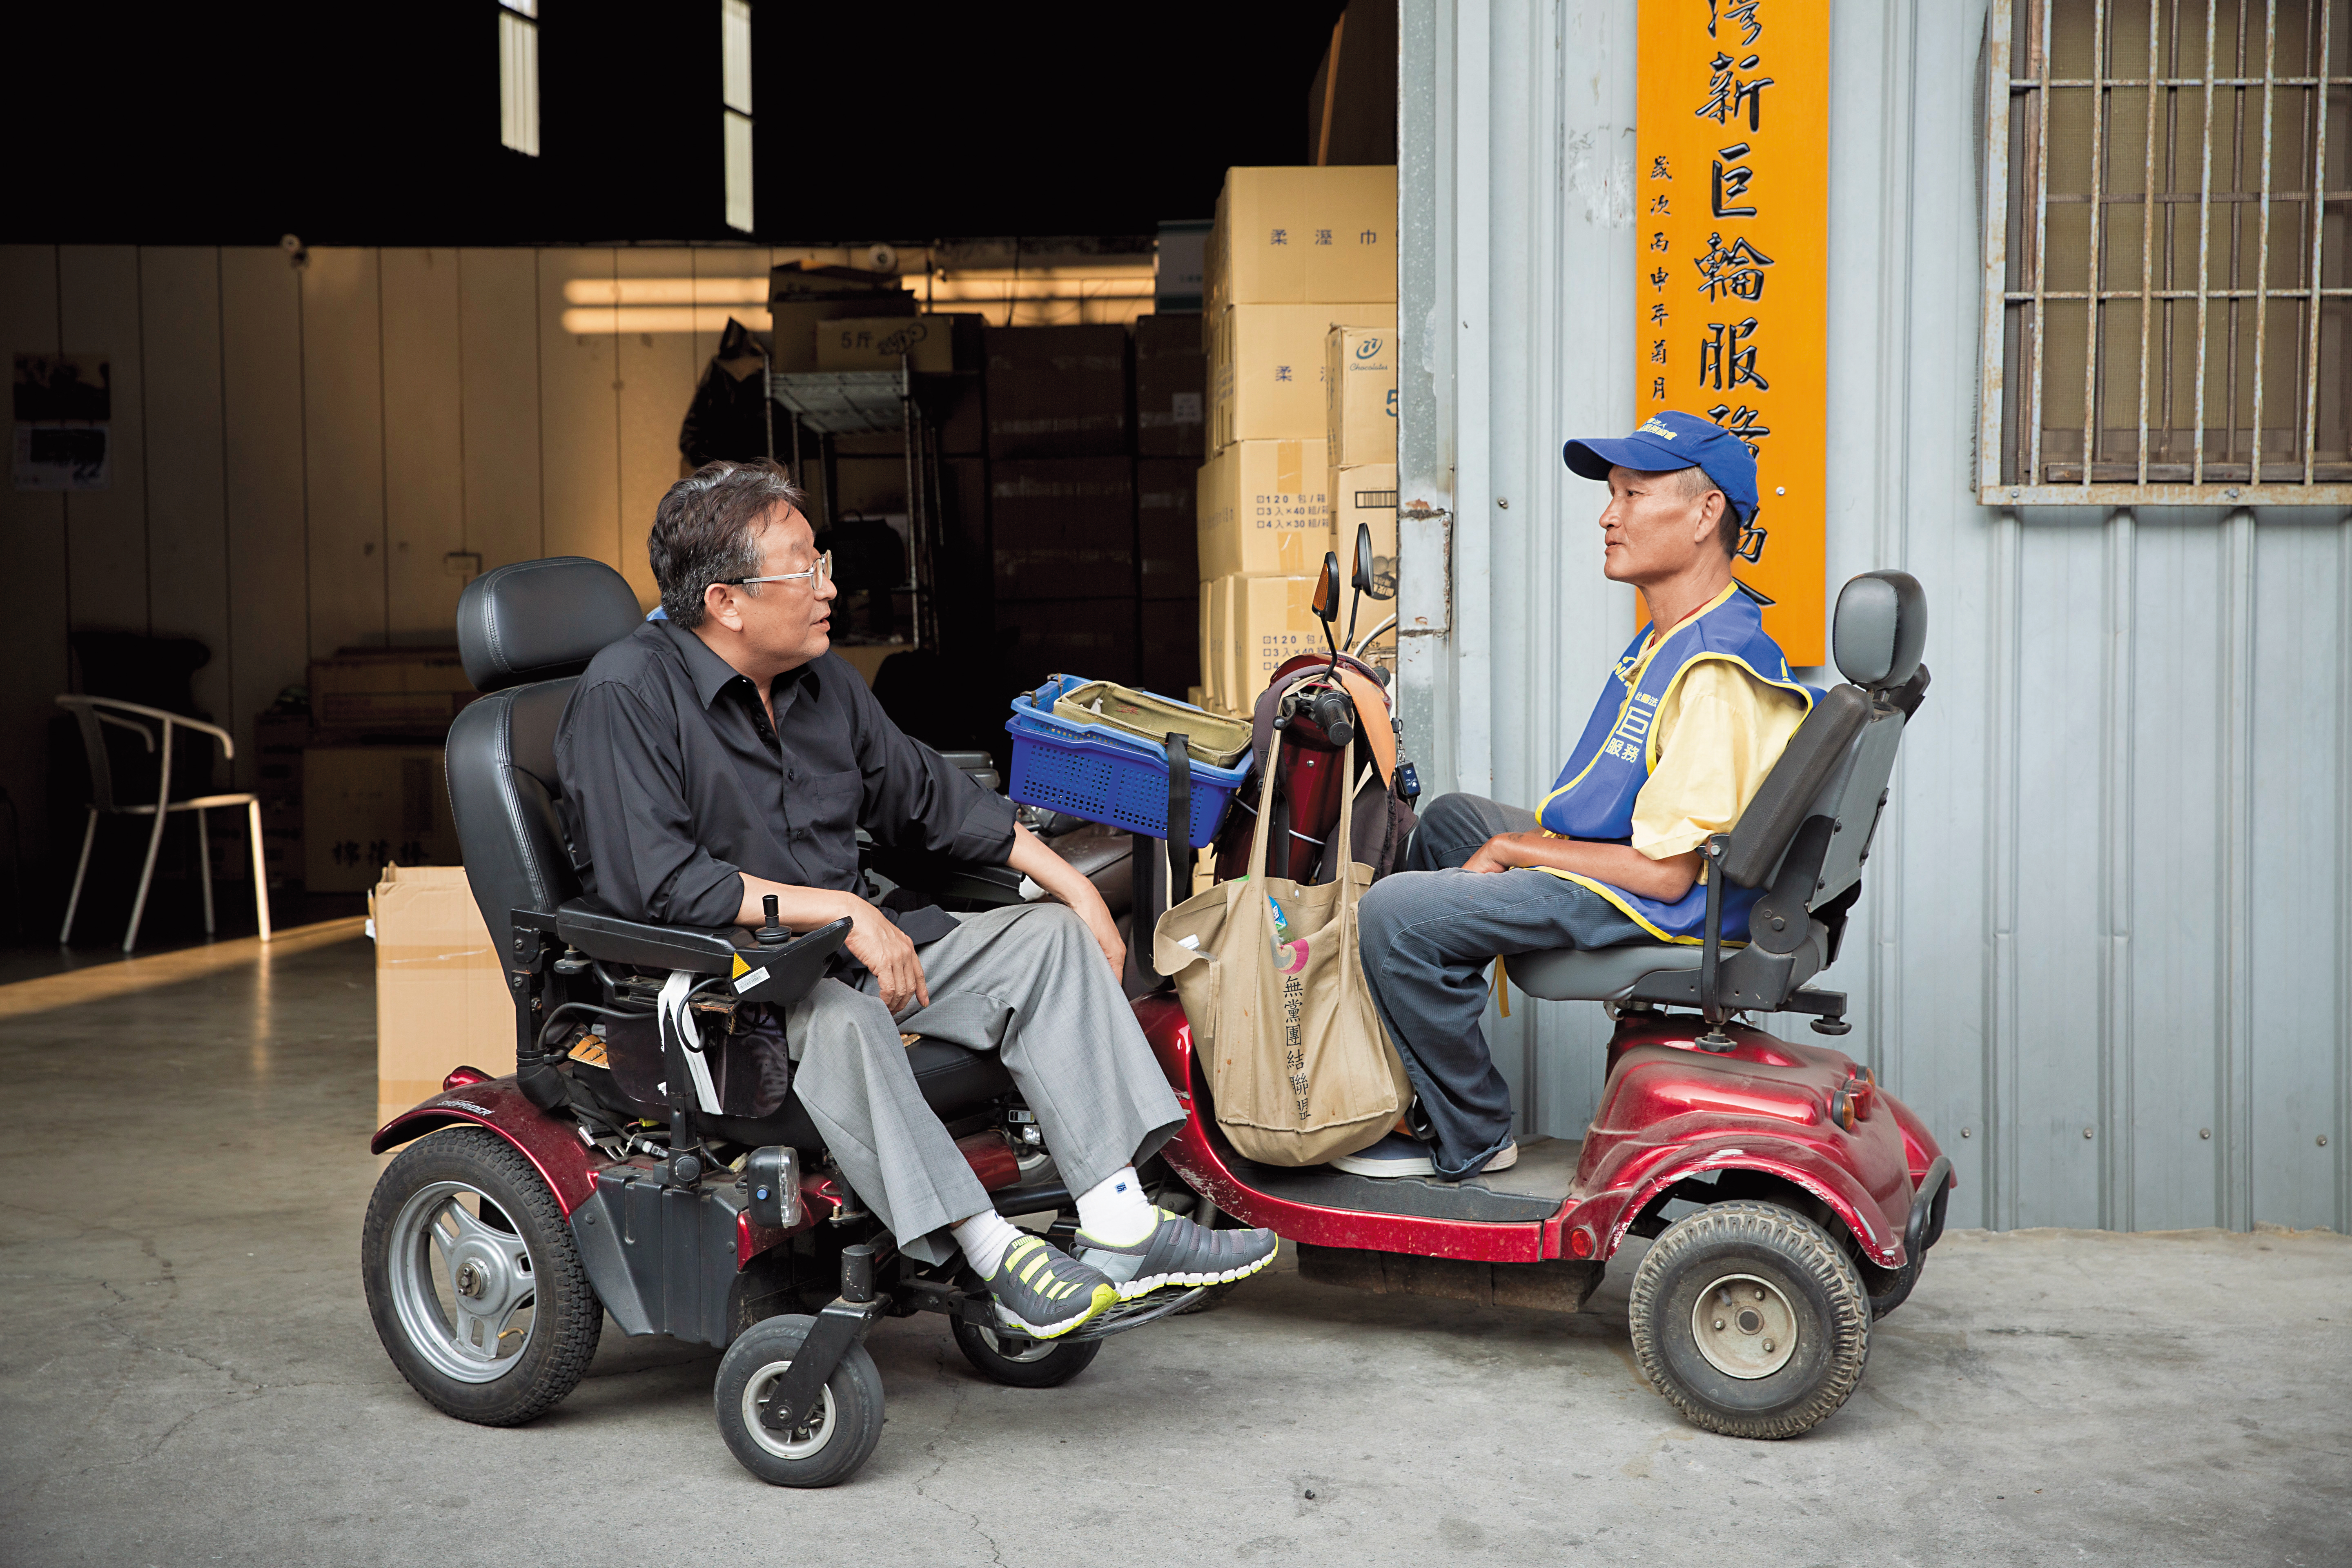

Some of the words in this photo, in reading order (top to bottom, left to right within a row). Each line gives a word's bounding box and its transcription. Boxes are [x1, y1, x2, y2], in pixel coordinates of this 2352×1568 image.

[1605, 738, 1639, 763] 服務
[1283, 976, 1312, 1120] 無黨團結聯盟
